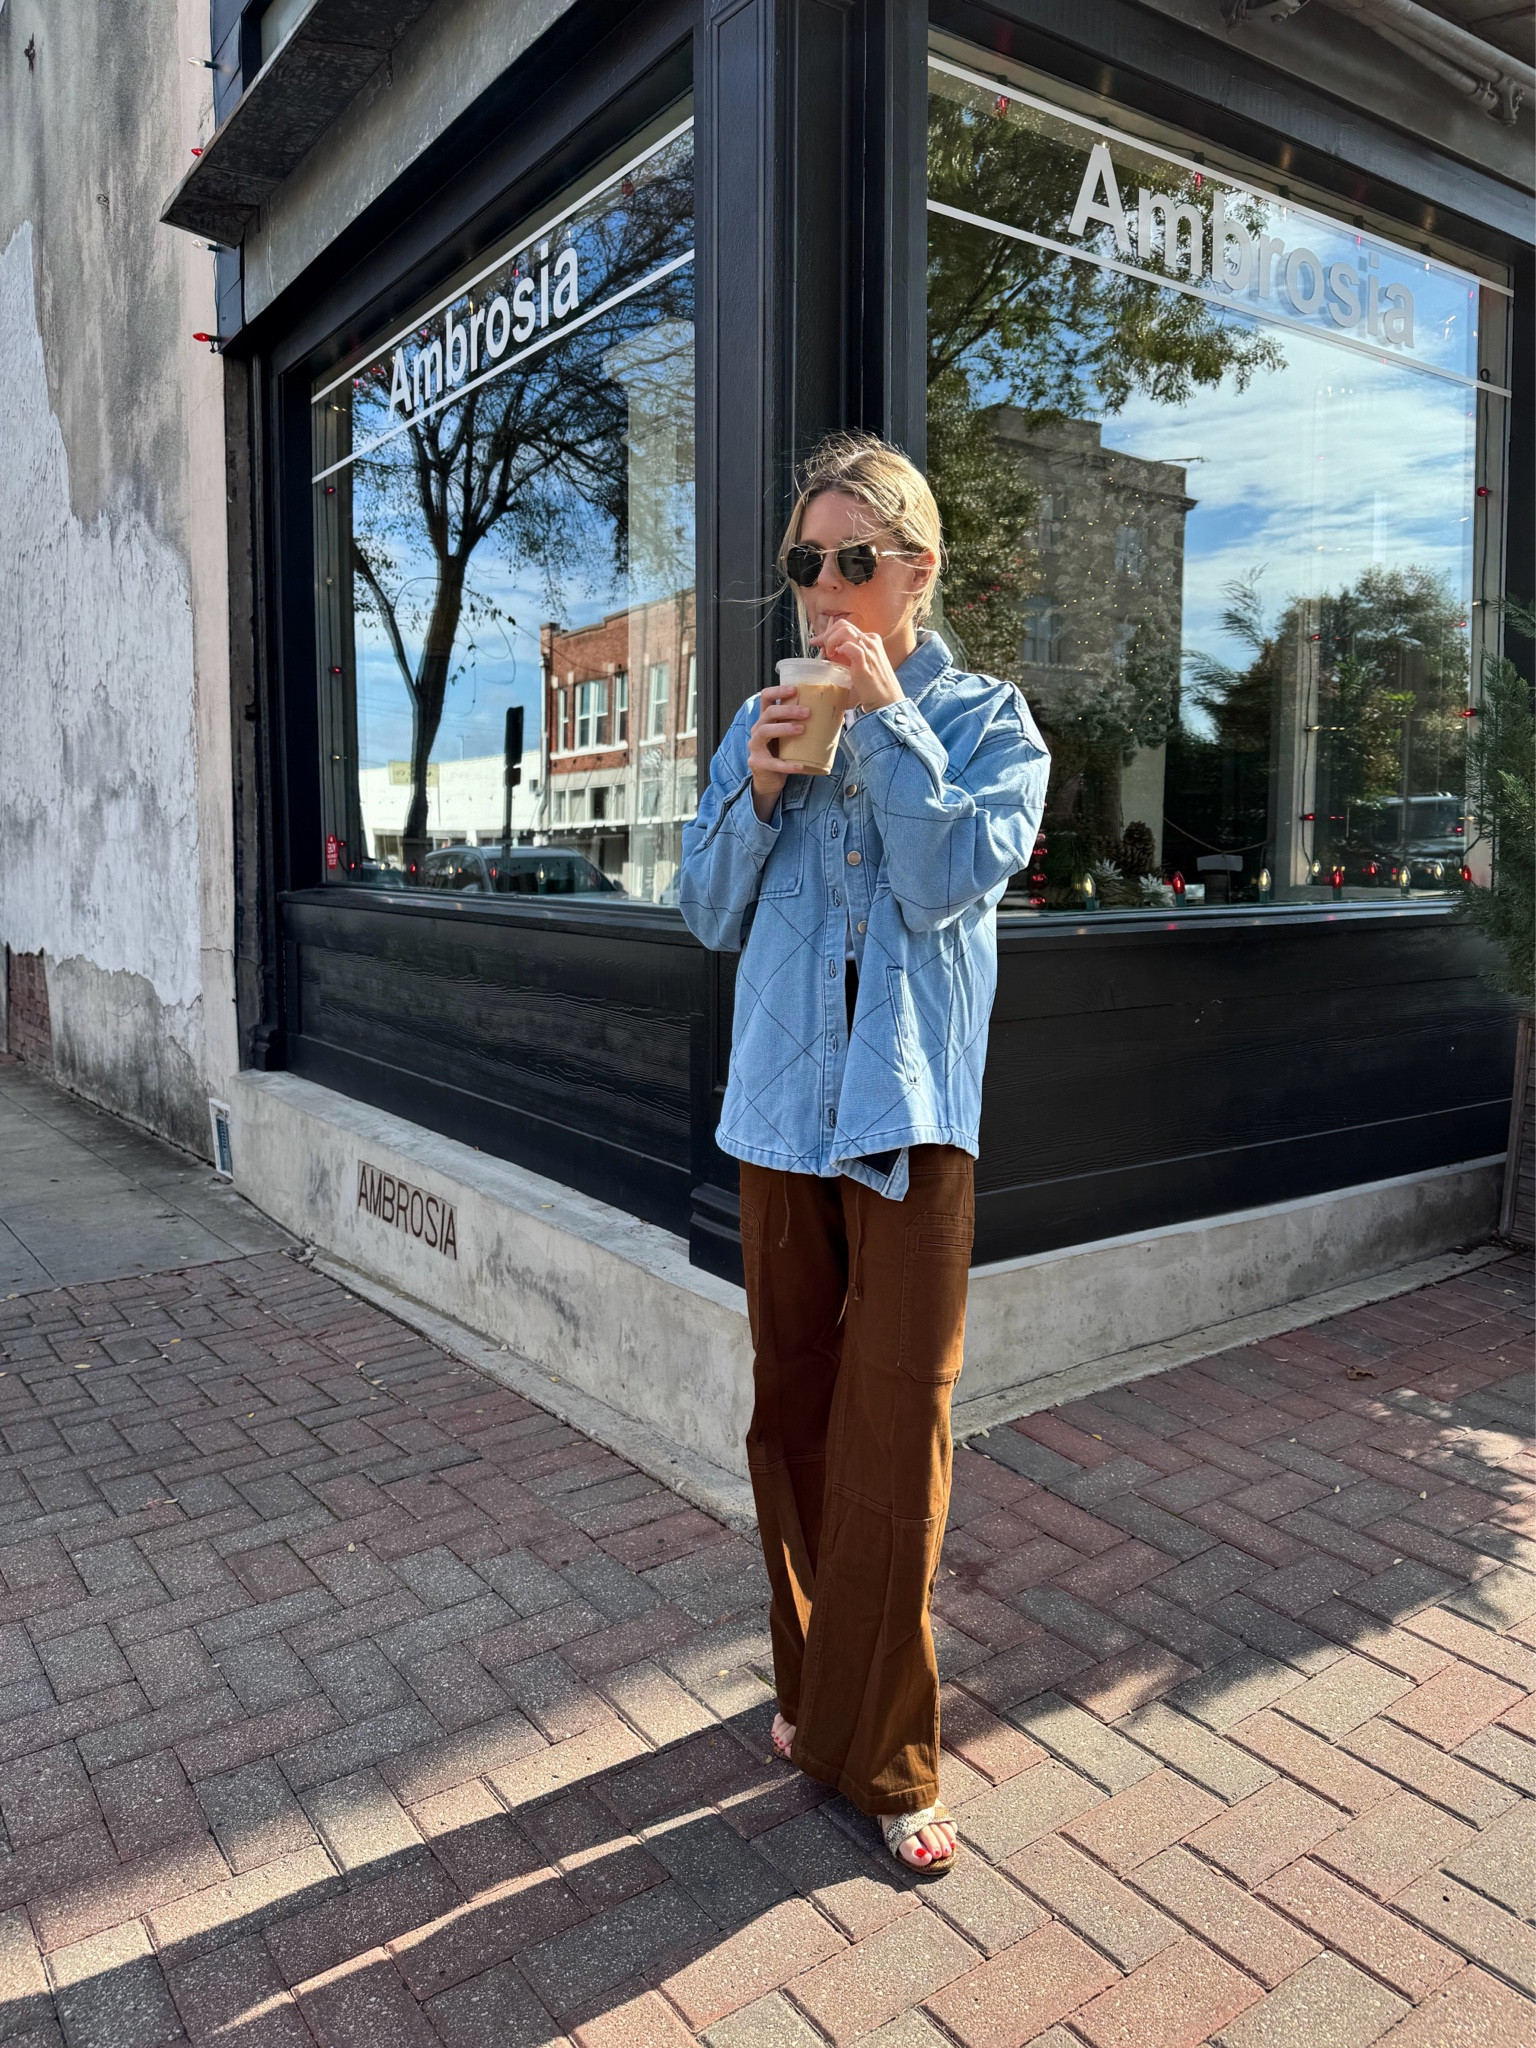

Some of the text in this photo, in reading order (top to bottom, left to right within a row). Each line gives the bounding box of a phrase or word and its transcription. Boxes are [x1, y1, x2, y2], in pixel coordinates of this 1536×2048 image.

[389, 241, 580, 422] Ambrosia
[1068, 143, 1415, 348] Ambrosia
[358, 1165, 458, 1260] AMBROSIA
